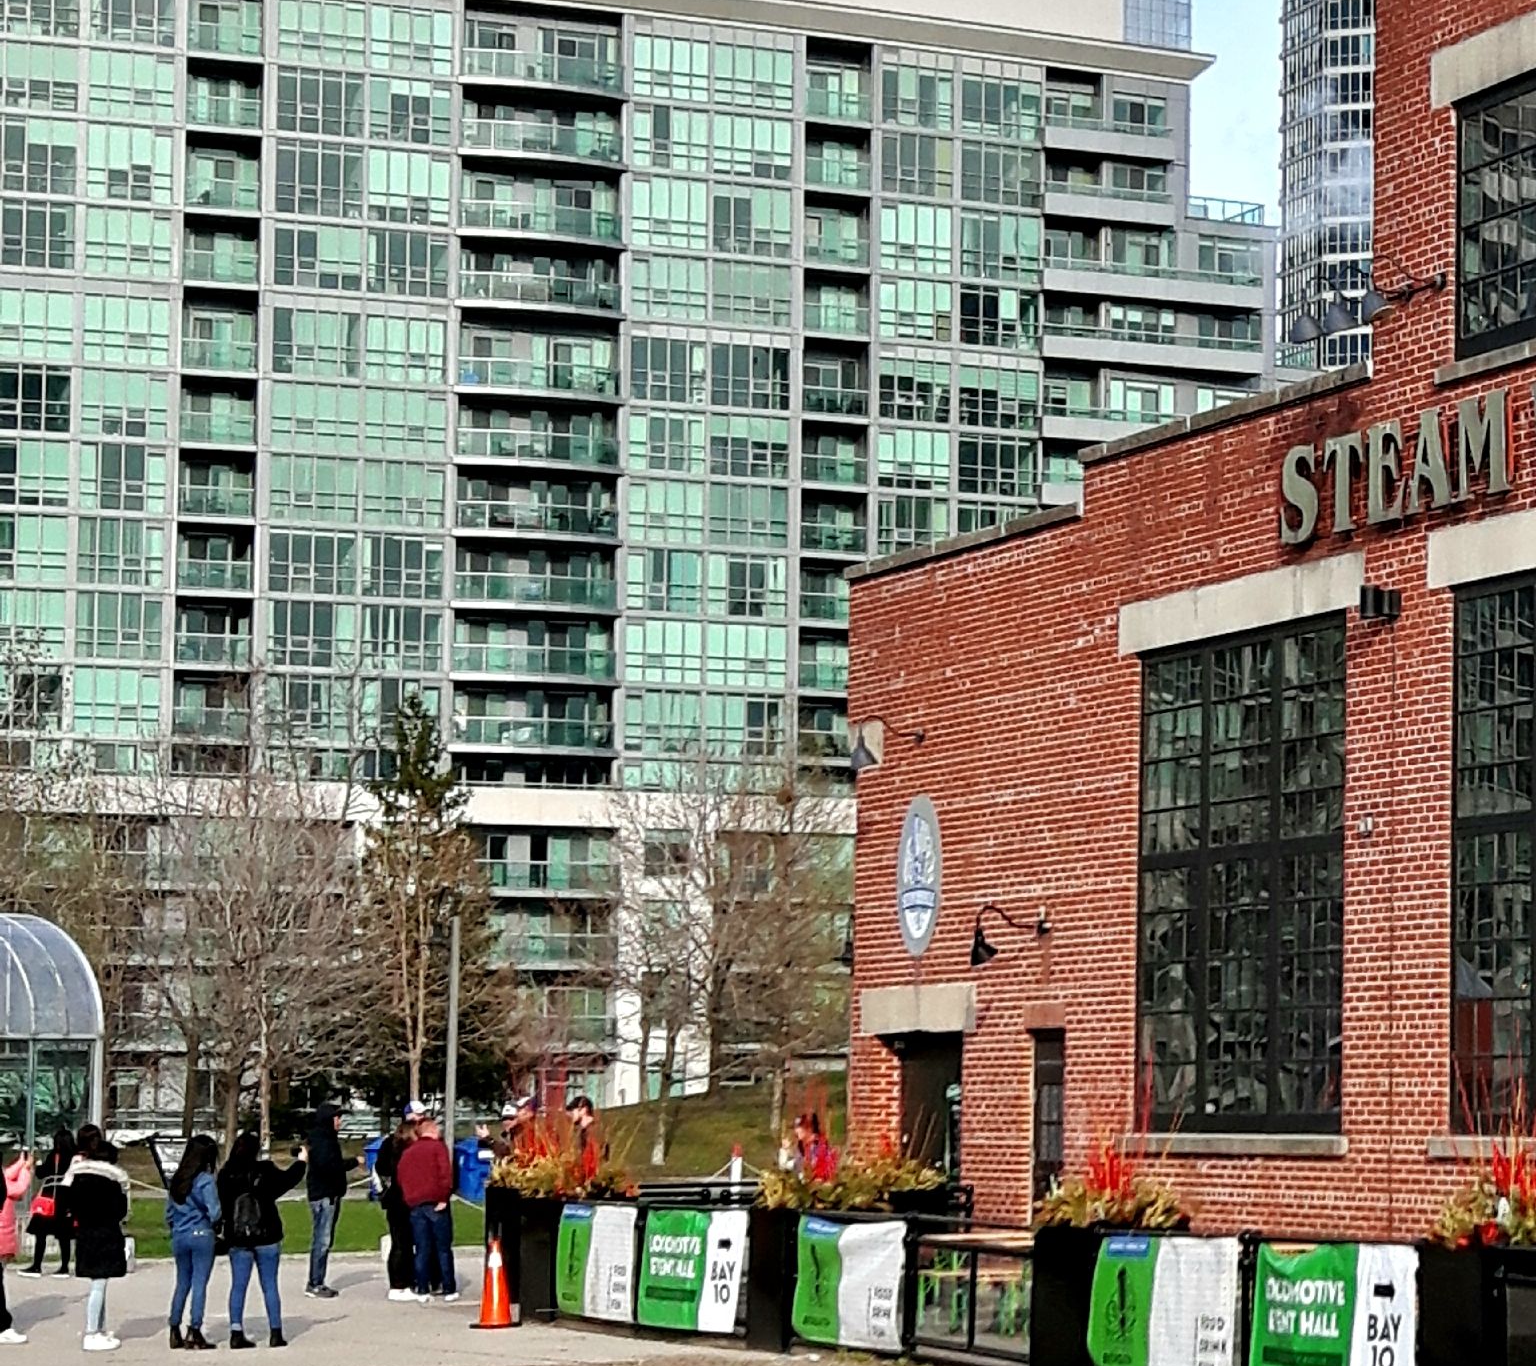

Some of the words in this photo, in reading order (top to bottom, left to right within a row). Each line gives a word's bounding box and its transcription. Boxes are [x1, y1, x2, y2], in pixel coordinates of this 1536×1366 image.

[1281, 388, 1512, 545] STEAM
[711, 1260, 737, 1282] BAY
[714, 1283, 731, 1304] 10
[1300, 1309, 1340, 1338] HALL
[1367, 1314, 1402, 1342] BAY
